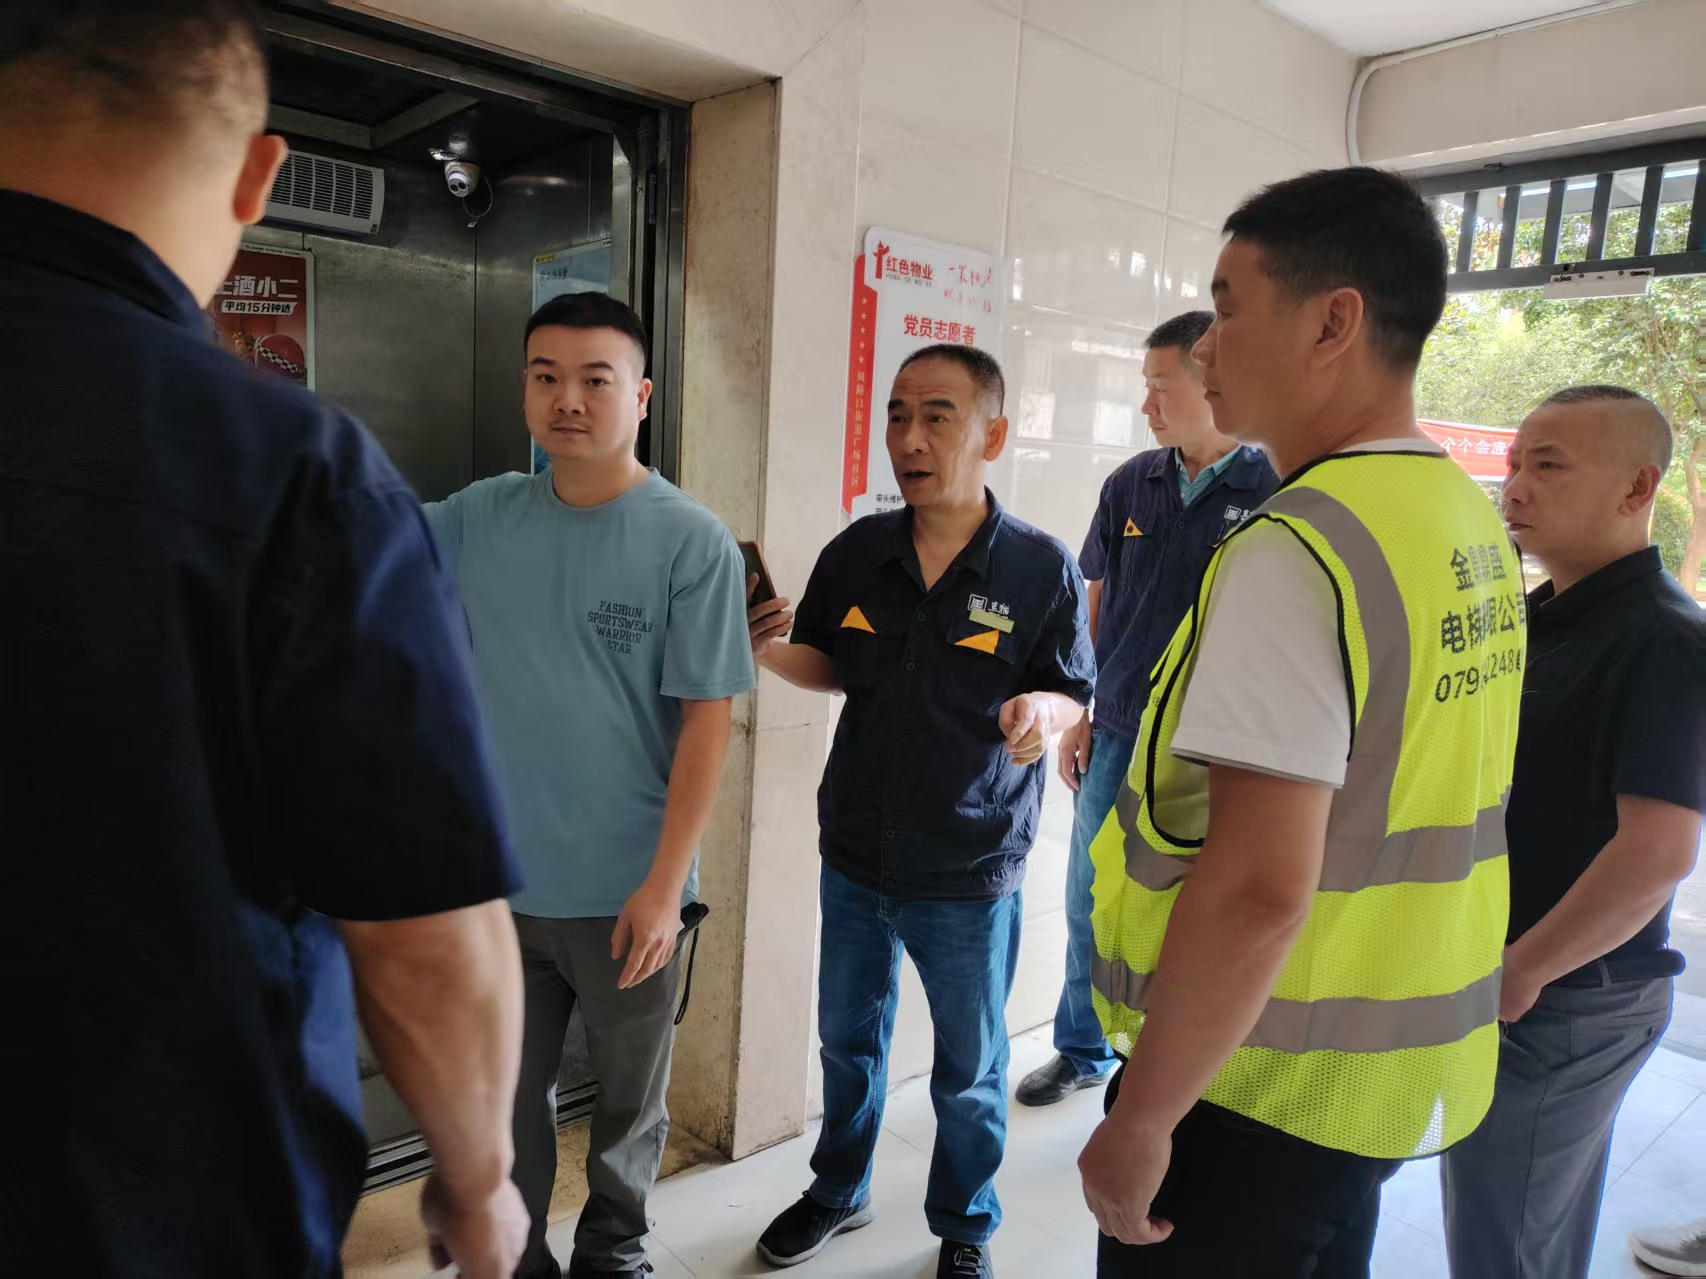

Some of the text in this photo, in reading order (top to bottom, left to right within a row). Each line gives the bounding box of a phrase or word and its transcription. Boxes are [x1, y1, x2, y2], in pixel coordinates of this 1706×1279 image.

[886, 256, 932, 281] 红色物业
[224, 301, 291, 313] 平均15分钟达
[903, 314, 976, 345] 党员志愿者
[1440, 436, 1513, 455] 个个会应
[599, 600, 644, 618] FASHION
[587, 611, 654, 633] SPORTSWEAR
[596, 625, 642, 644] WARRIOR
[607, 640, 632, 655] STAR
